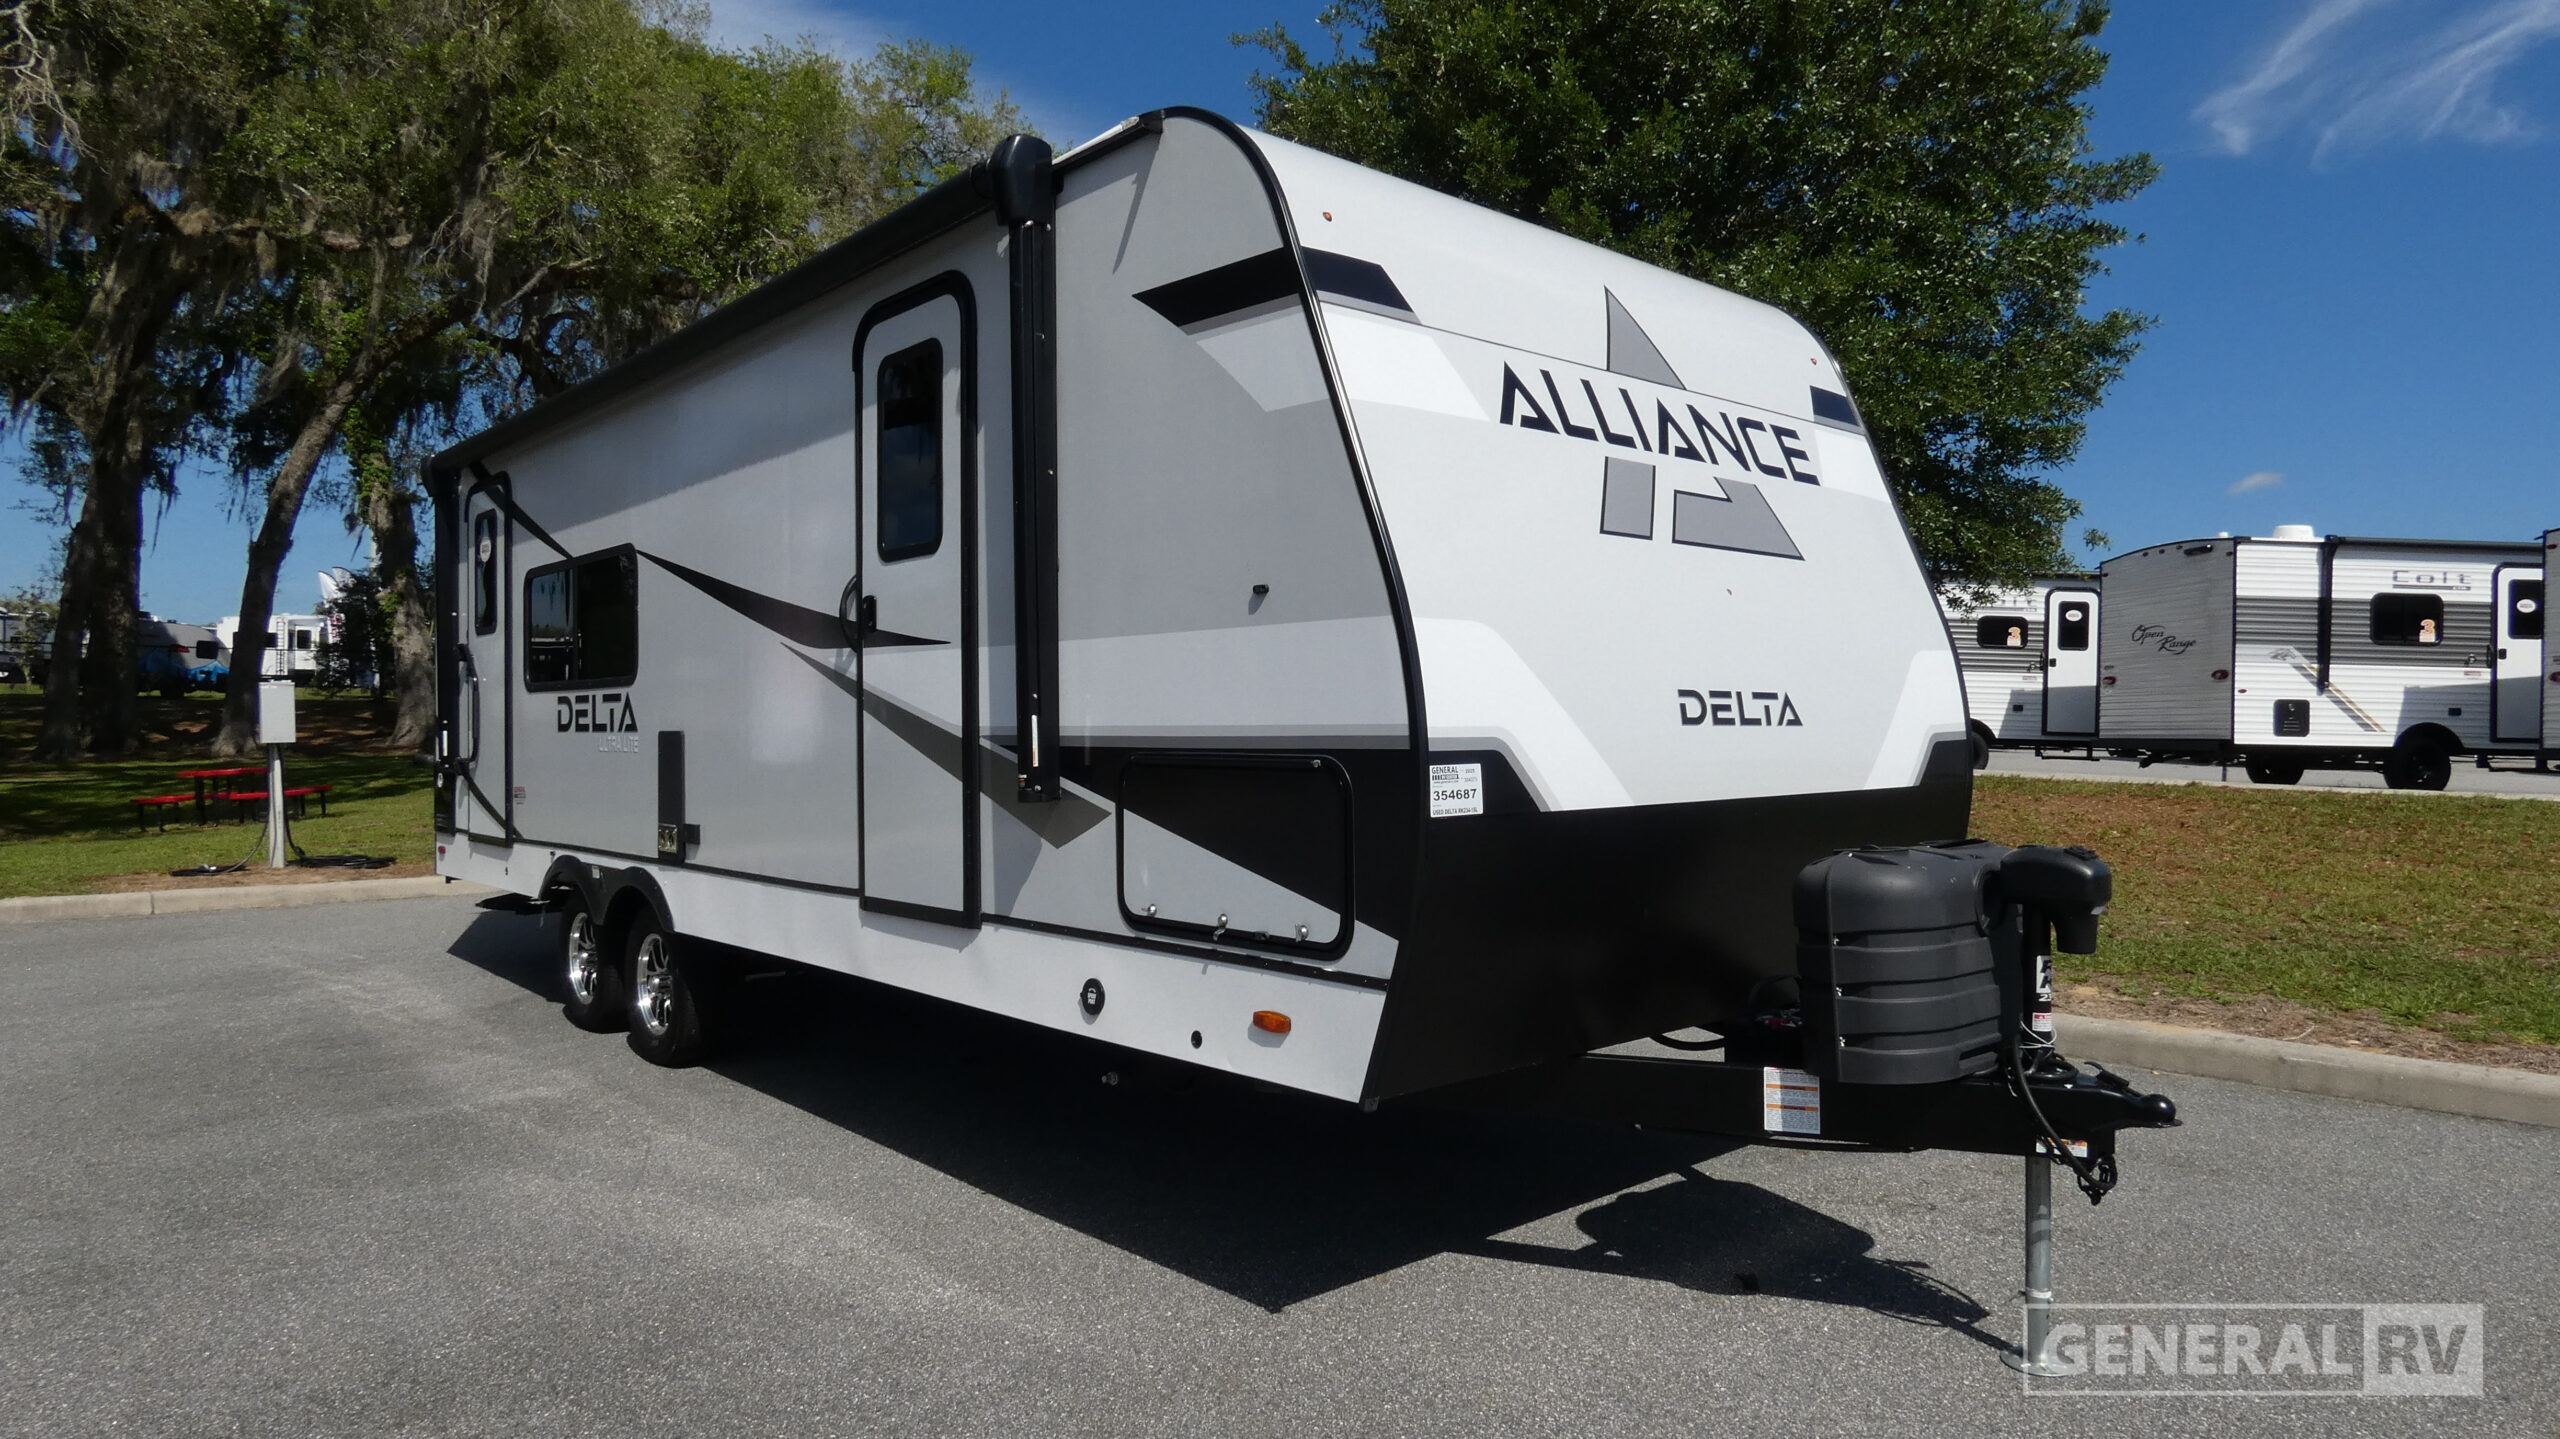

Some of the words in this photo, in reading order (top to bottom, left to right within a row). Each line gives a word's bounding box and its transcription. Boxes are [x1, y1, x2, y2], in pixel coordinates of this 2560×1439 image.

[1500, 361, 1821, 486] ALLIANCE
[2393, 570, 2472, 585] Colt
[2132, 624, 2166, 646] Open
[2156, 635, 2197, 656] Range
[557, 691, 638, 733] DELTA
[1677, 689, 1803, 727] DELTA
[1431, 766, 1459, 775] GENERAL
[1433, 788, 1477, 801] 354687
[1445, 807, 1457, 815] DELTA
